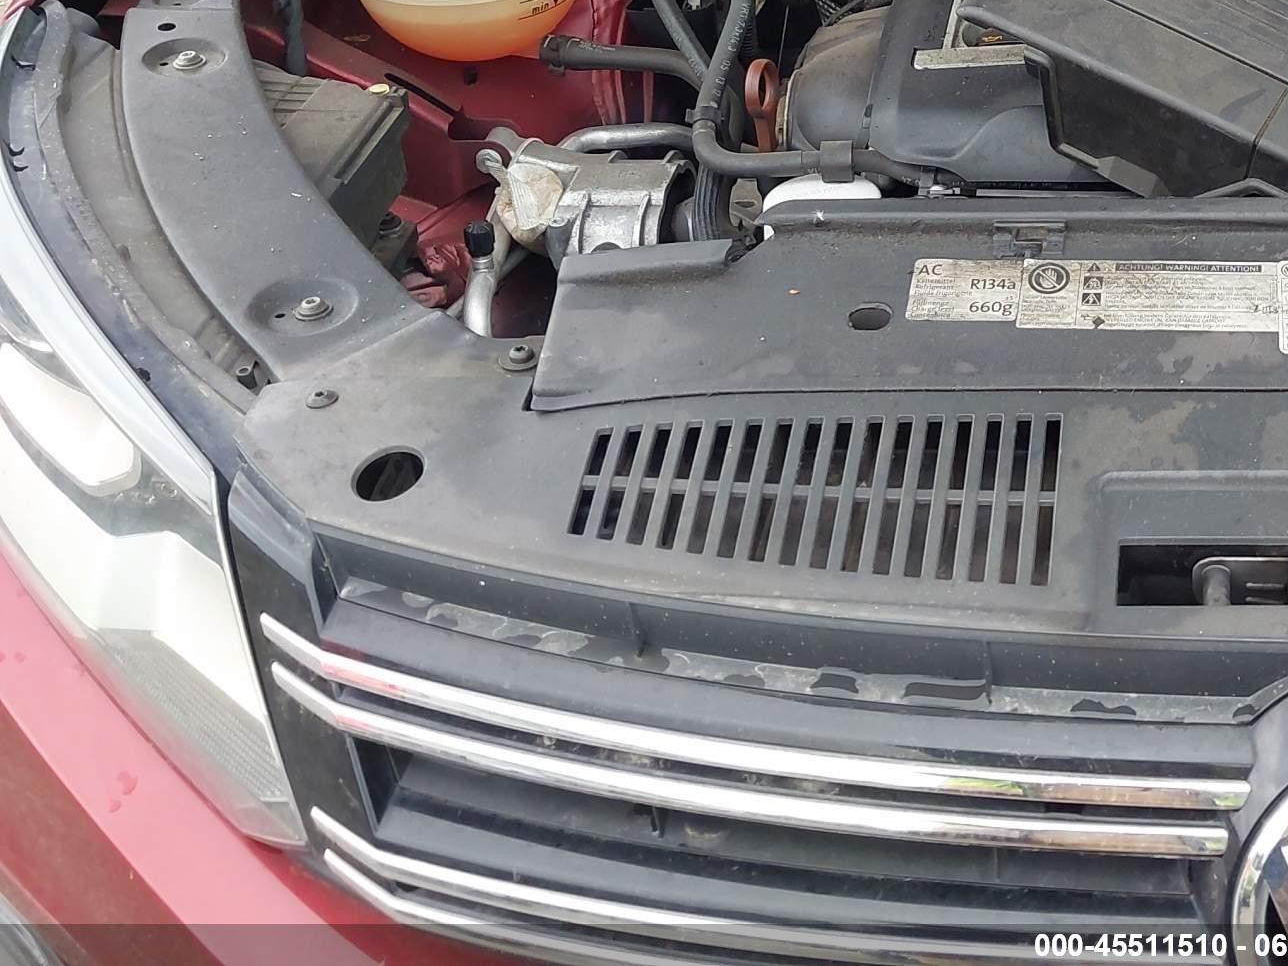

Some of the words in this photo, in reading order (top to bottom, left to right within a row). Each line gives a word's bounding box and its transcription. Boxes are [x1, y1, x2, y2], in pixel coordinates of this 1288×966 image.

[532, 2, 549, 14] min
[720, 60, 731, 70] 05
[716, 76, 726, 85] 13
[918, 264, 943, 276] AC
[1118, 264, 1163, 272] ACHTUNG!
[1166, 264, 1209, 272] WARNING!
[1211, 265, 1260, 273] ATTENTION!
[970, 278, 1016, 290] R134a
[970, 301, 1013, 316] 660g
